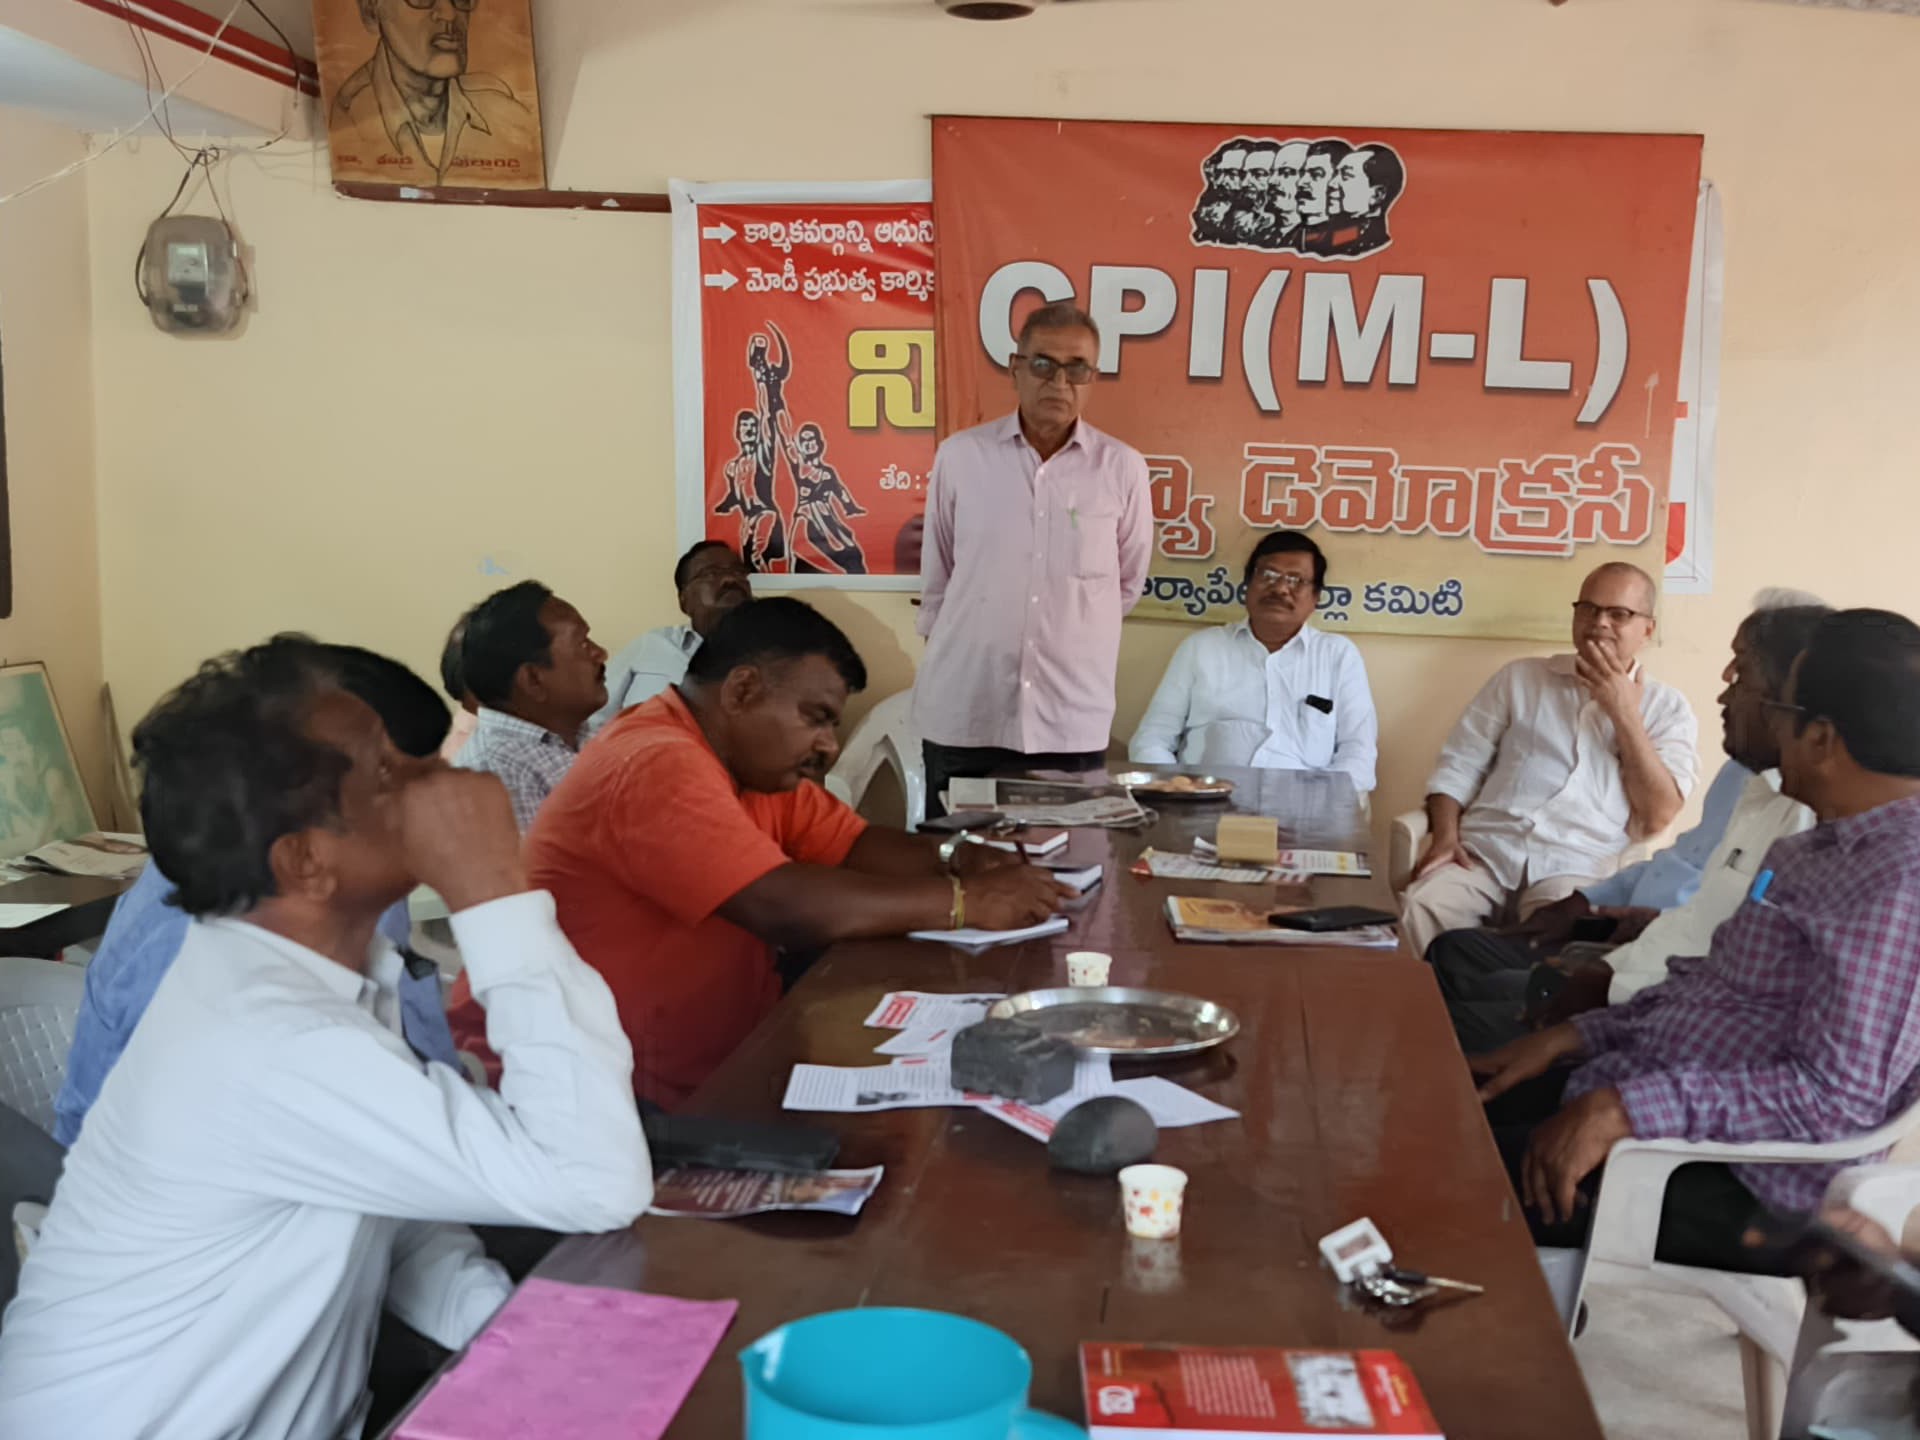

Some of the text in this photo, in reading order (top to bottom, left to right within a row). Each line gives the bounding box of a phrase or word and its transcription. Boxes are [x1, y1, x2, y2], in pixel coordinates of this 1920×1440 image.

[743, 218, 874, 257] కార్మికవర్గాన్ని
[746, 257, 799, 293] మోడీ
[802, 267, 876, 302] ప్రభుత్వ
